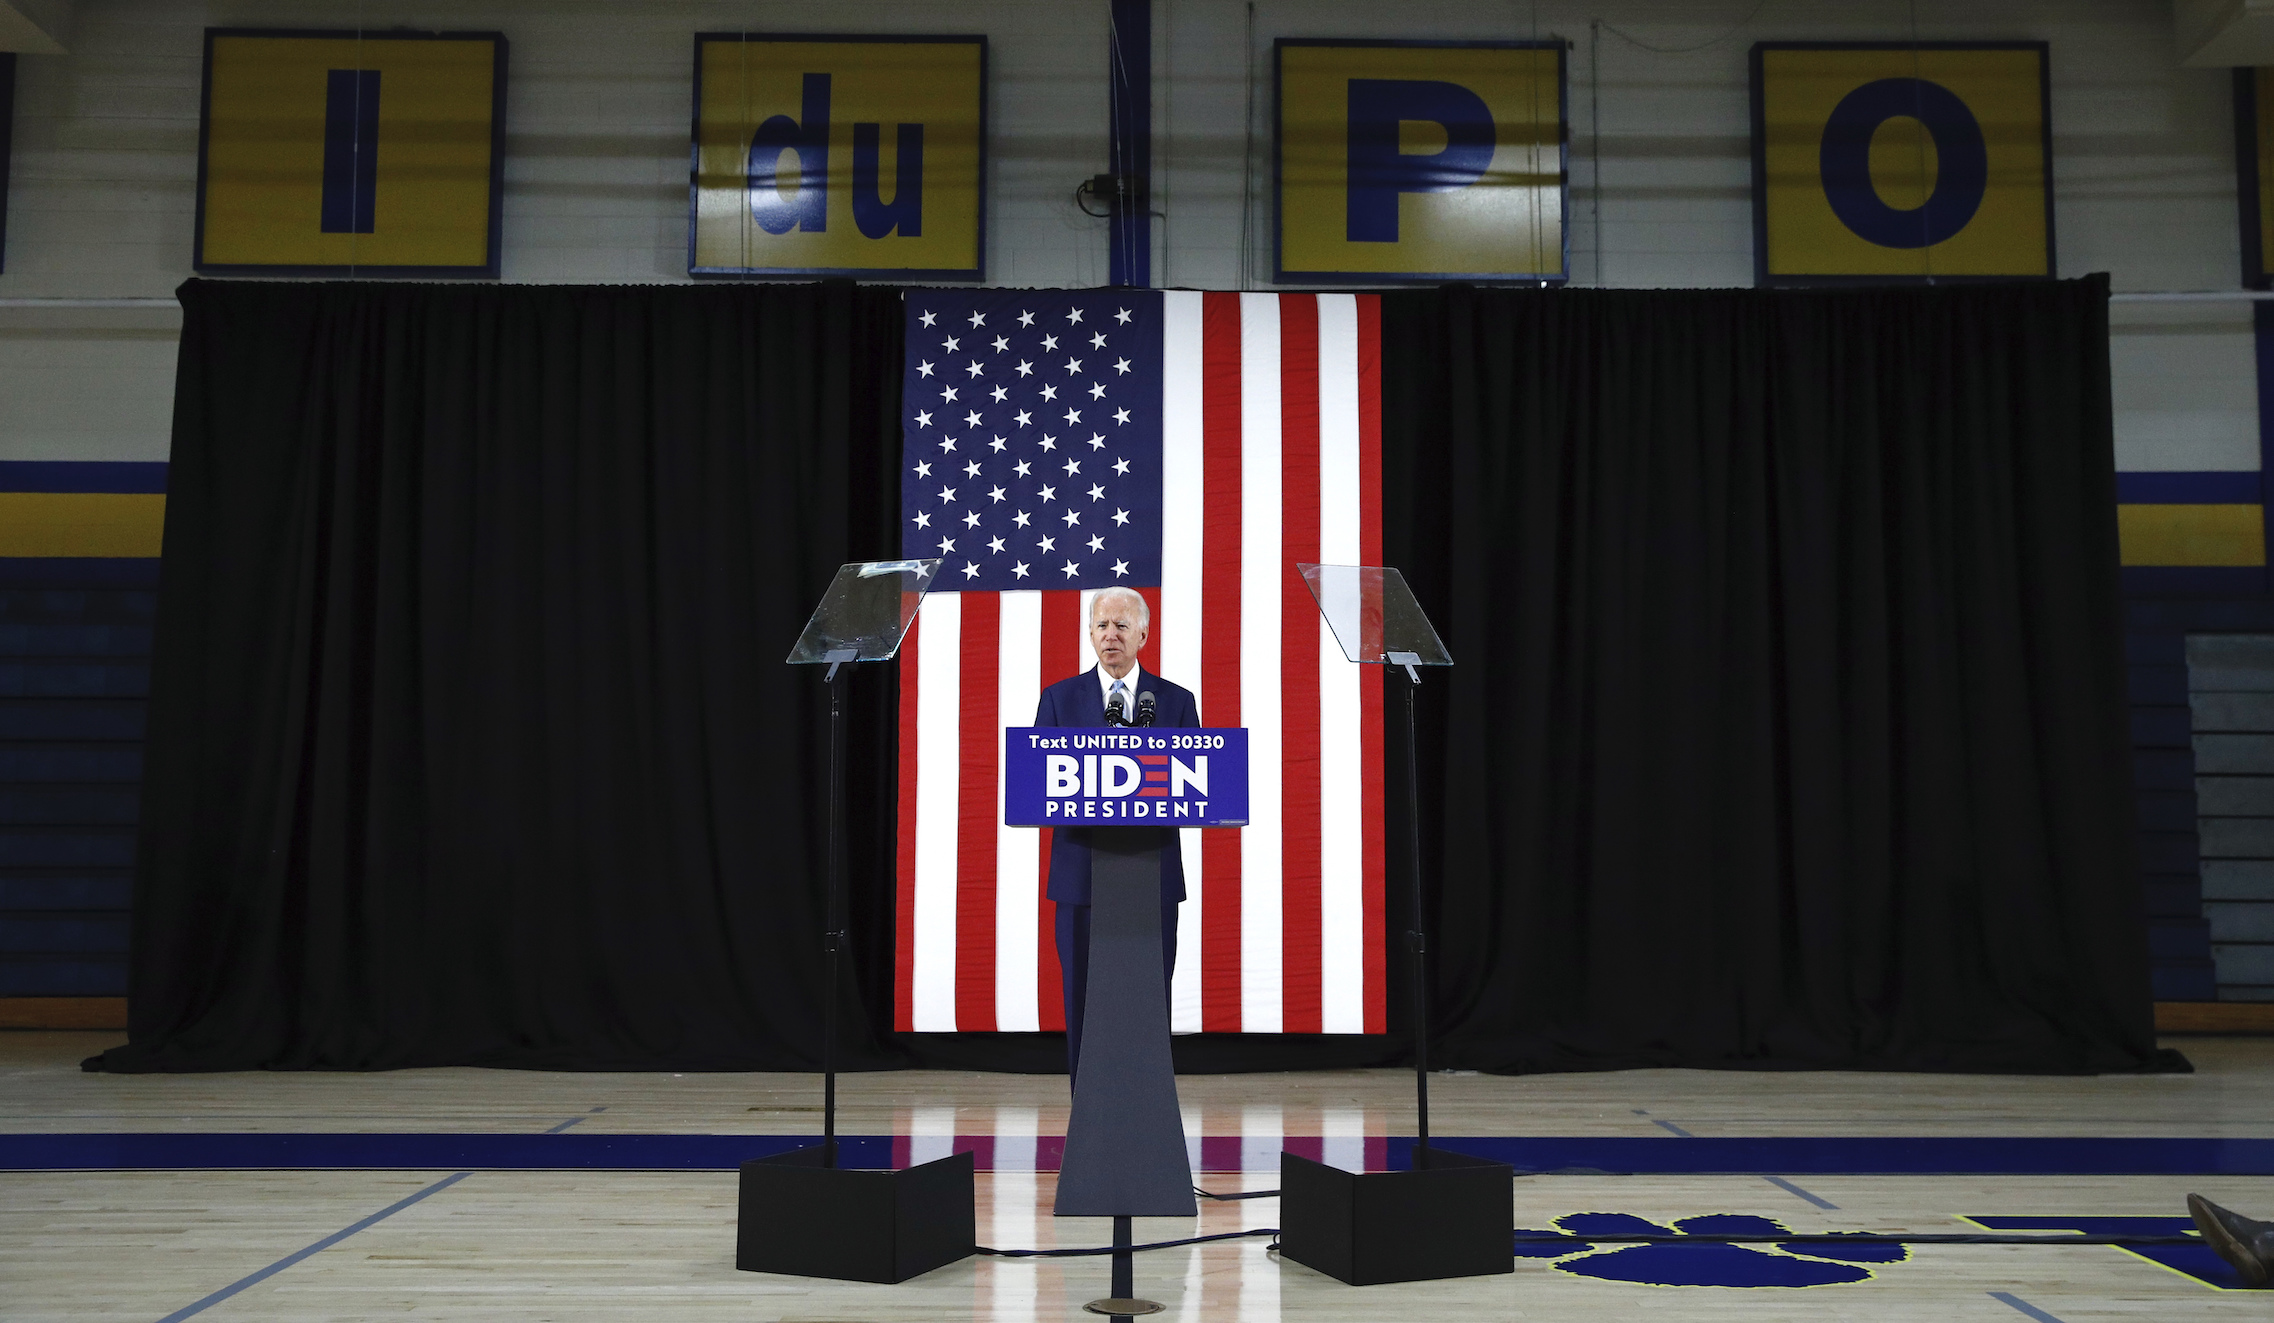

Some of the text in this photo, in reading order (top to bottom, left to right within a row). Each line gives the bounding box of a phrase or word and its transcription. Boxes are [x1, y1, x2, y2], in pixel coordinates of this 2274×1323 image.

[320, 69, 381, 234] I
[749, 72, 924, 240] du
[1346, 78, 1497, 243] P
[1819, 76, 1988, 249] O
[1028, 734, 1225, 749] Text UNITED to 30330
[1045, 754, 1209, 798] BIDEN
[1045, 800, 1209, 818] PRESIDENT
